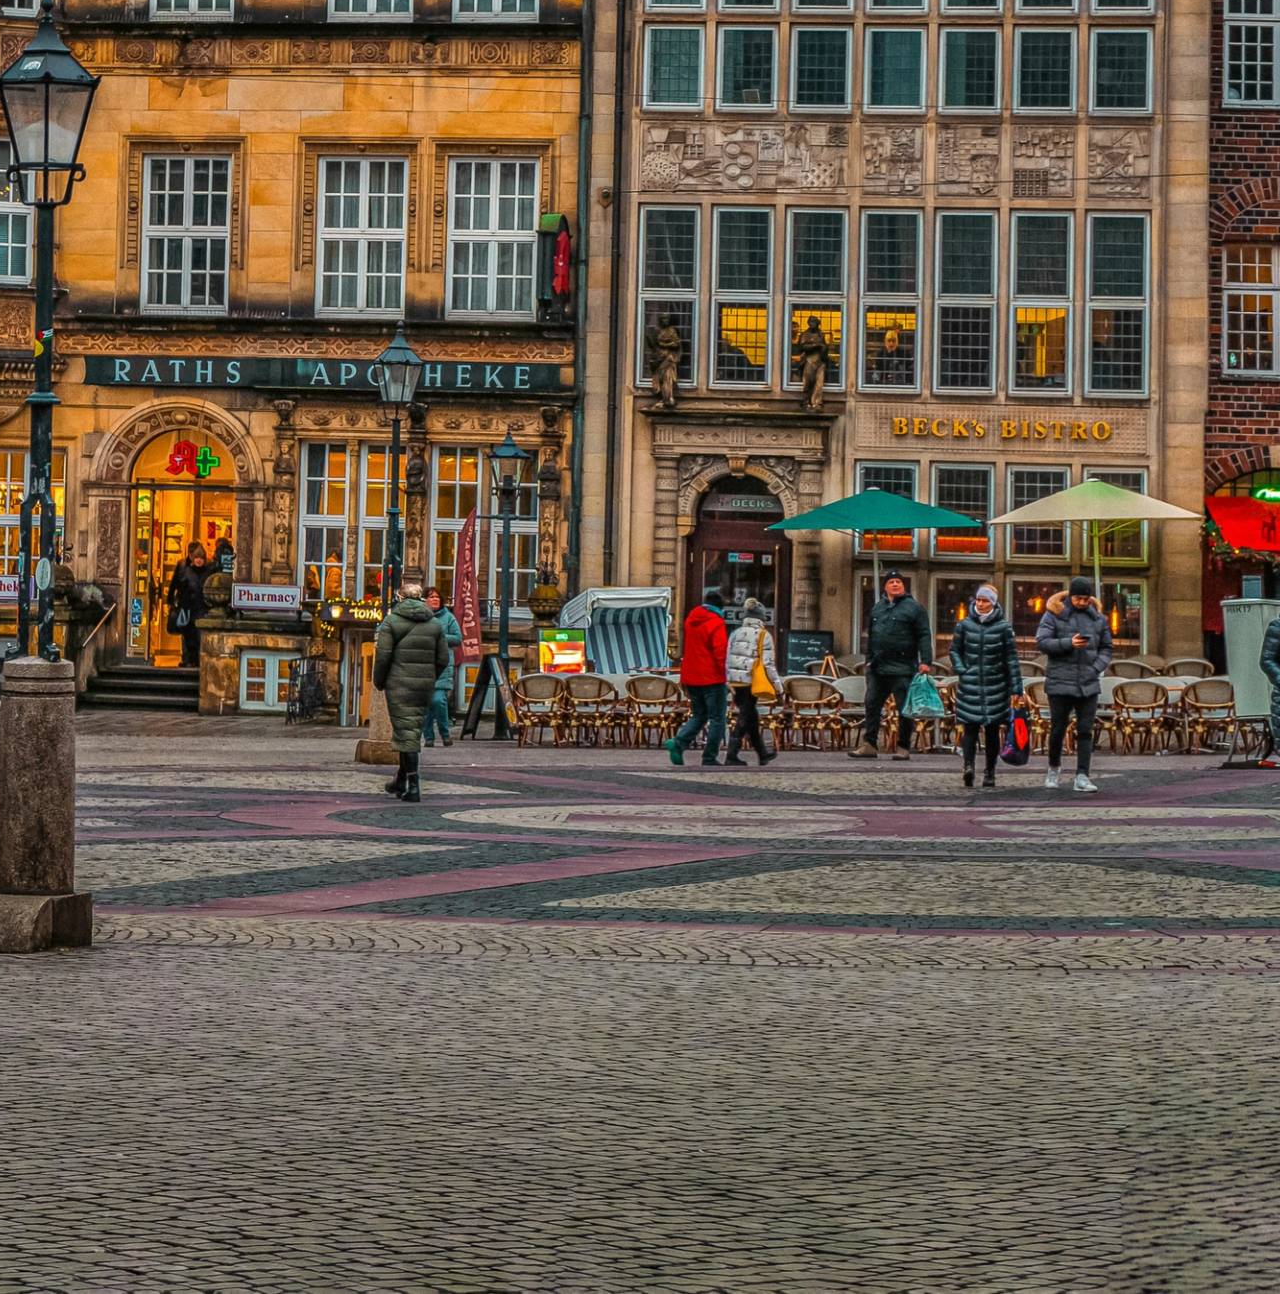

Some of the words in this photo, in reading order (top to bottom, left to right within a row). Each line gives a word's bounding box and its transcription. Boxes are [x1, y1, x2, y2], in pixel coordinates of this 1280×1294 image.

[114, 359, 241, 384] RATHS
[309, 362, 531, 389] APOHEKE
[1001, 419, 1112, 440] BISTRO
[238, 589, 297, 605] Pharmacy
